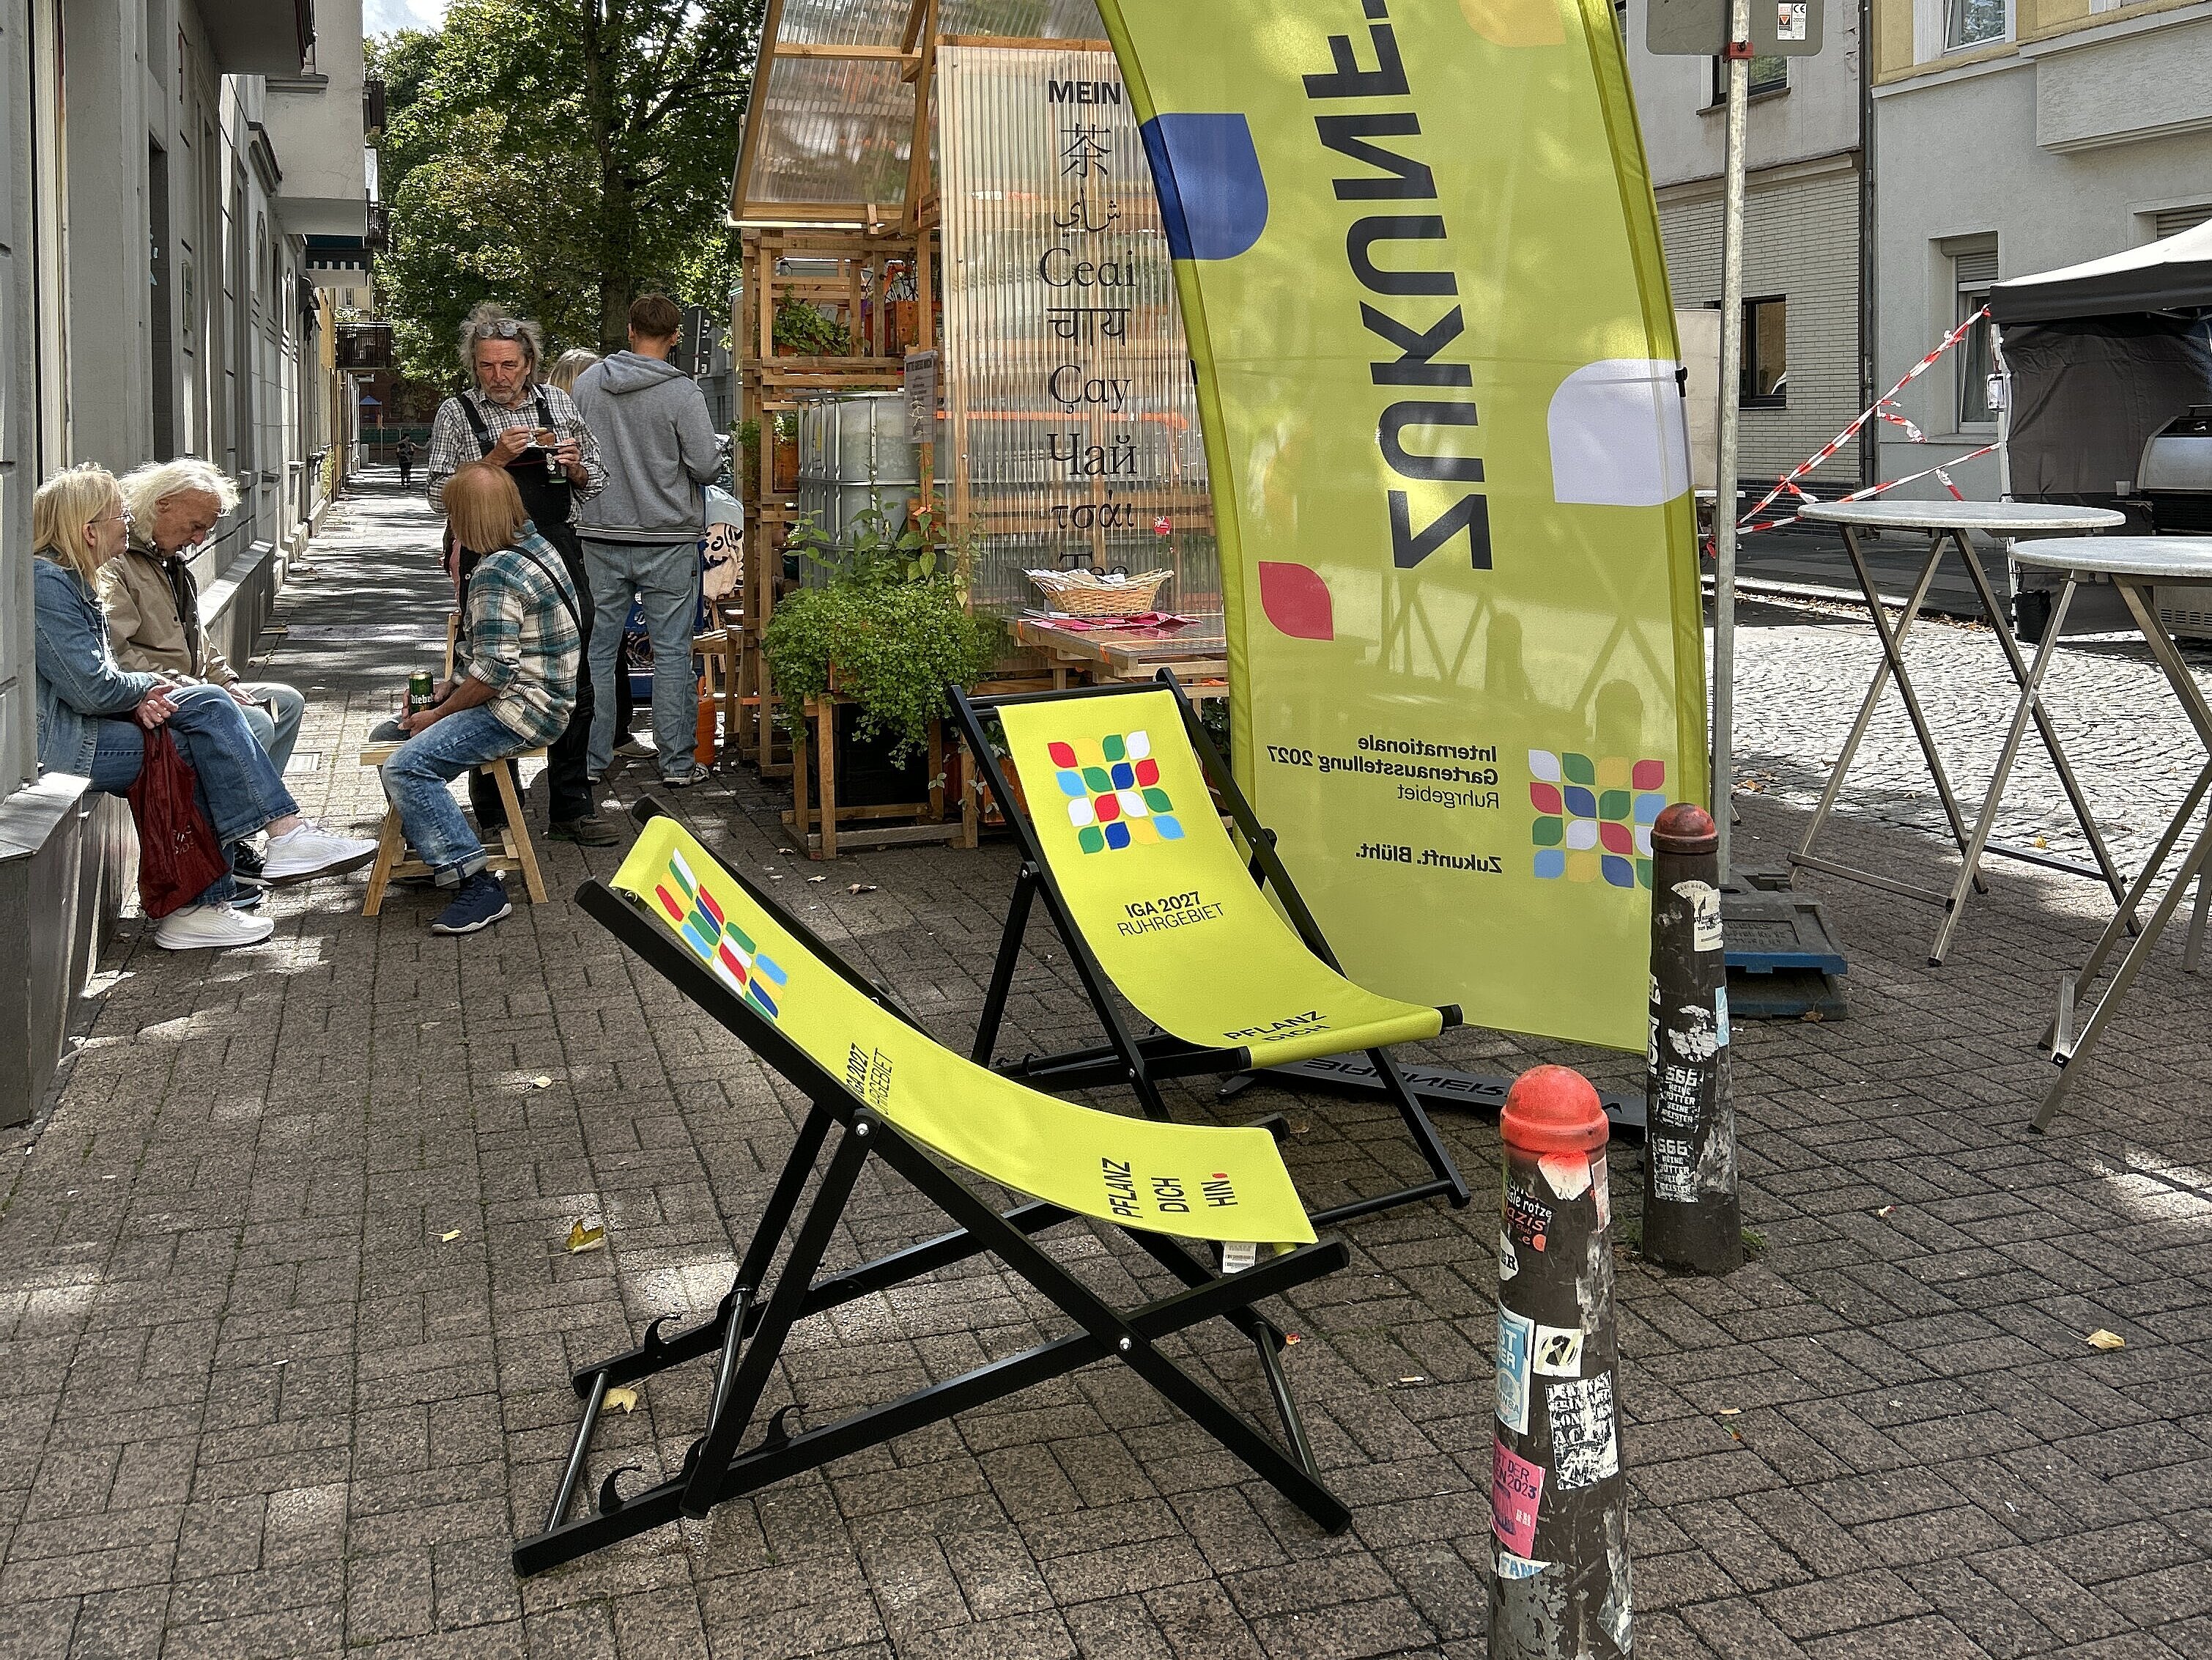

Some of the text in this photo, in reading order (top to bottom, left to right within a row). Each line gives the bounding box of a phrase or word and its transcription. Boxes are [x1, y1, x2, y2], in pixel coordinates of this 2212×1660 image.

[1048, 81, 1120, 104] MEIN
[1060, 123, 1112, 177] 茶
[1040, 248, 1136, 287] Ceai
[1046, 308, 1131, 347] चाय
[1049, 365, 1132, 413] Çay
[1047, 433, 1137, 475] Чай
[1117, 902, 1224, 936] RUHRGEBIET
[1125, 891, 1200, 918] IGA 2027
[1223, 1011, 1327, 1039] PFLANZ
[1262, 1025, 1331, 1041] DICH
[847, 1042, 869, 1081] 2027
[1101, 1157, 1143, 1218] PFLANZ
[1150, 1177, 1191, 1213] DICH
[1506, 1206, 1546, 1232] azis
[1507, 1474, 1537, 1499] 2023
[1508, 1459, 1530, 1483] DER
